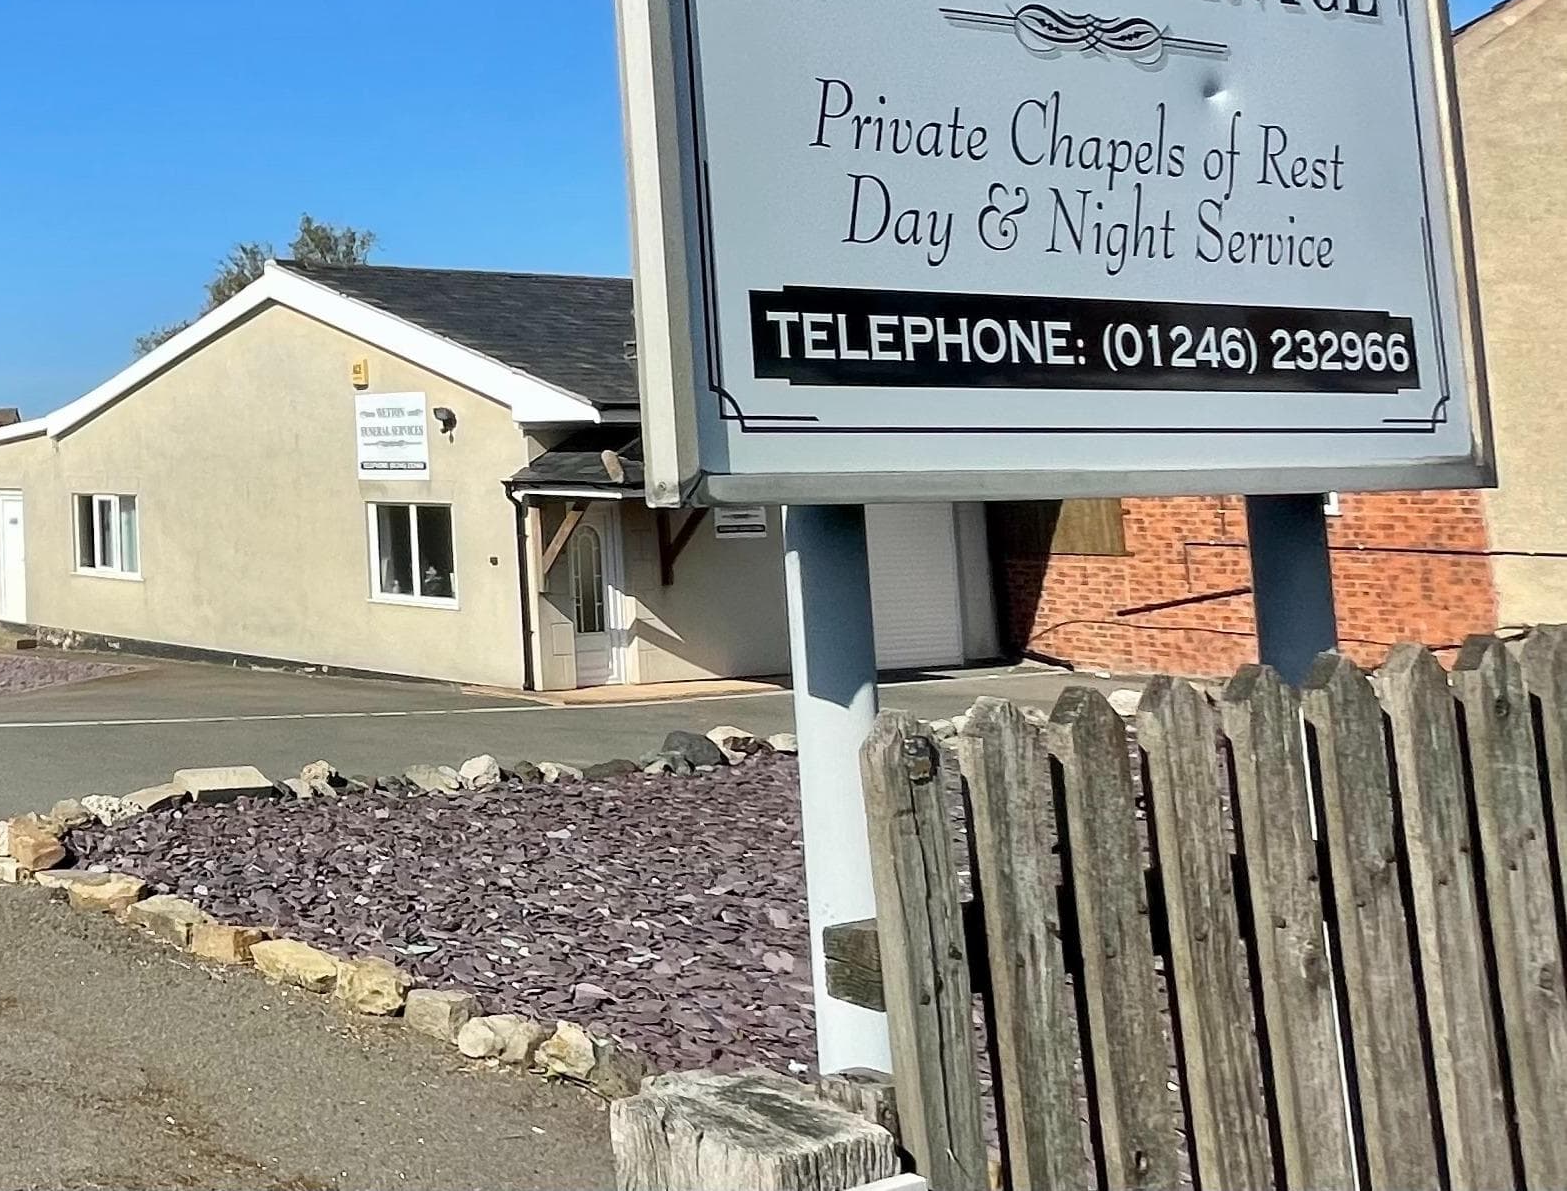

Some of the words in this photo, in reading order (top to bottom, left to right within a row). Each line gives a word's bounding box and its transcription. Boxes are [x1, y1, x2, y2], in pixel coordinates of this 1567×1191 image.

[808, 77, 990, 161] Private
[1010, 90, 1186, 191] Chapels
[1202, 110, 1242, 201] of
[1256, 124, 1345, 191] Rest
[840, 173, 955, 267] Day
[976, 182, 1030, 252] &
[1044, 182, 1177, 276] Night
[1194, 198, 1335, 269] Service
[764, 310, 1087, 366] TELEPHONE:
[1102, 322, 1259, 376] (01246)
[1269, 328, 1411, 373] 232966
[360, 426, 390, 437] FUNERAL
[392, 425, 424, 436] SERVICES
